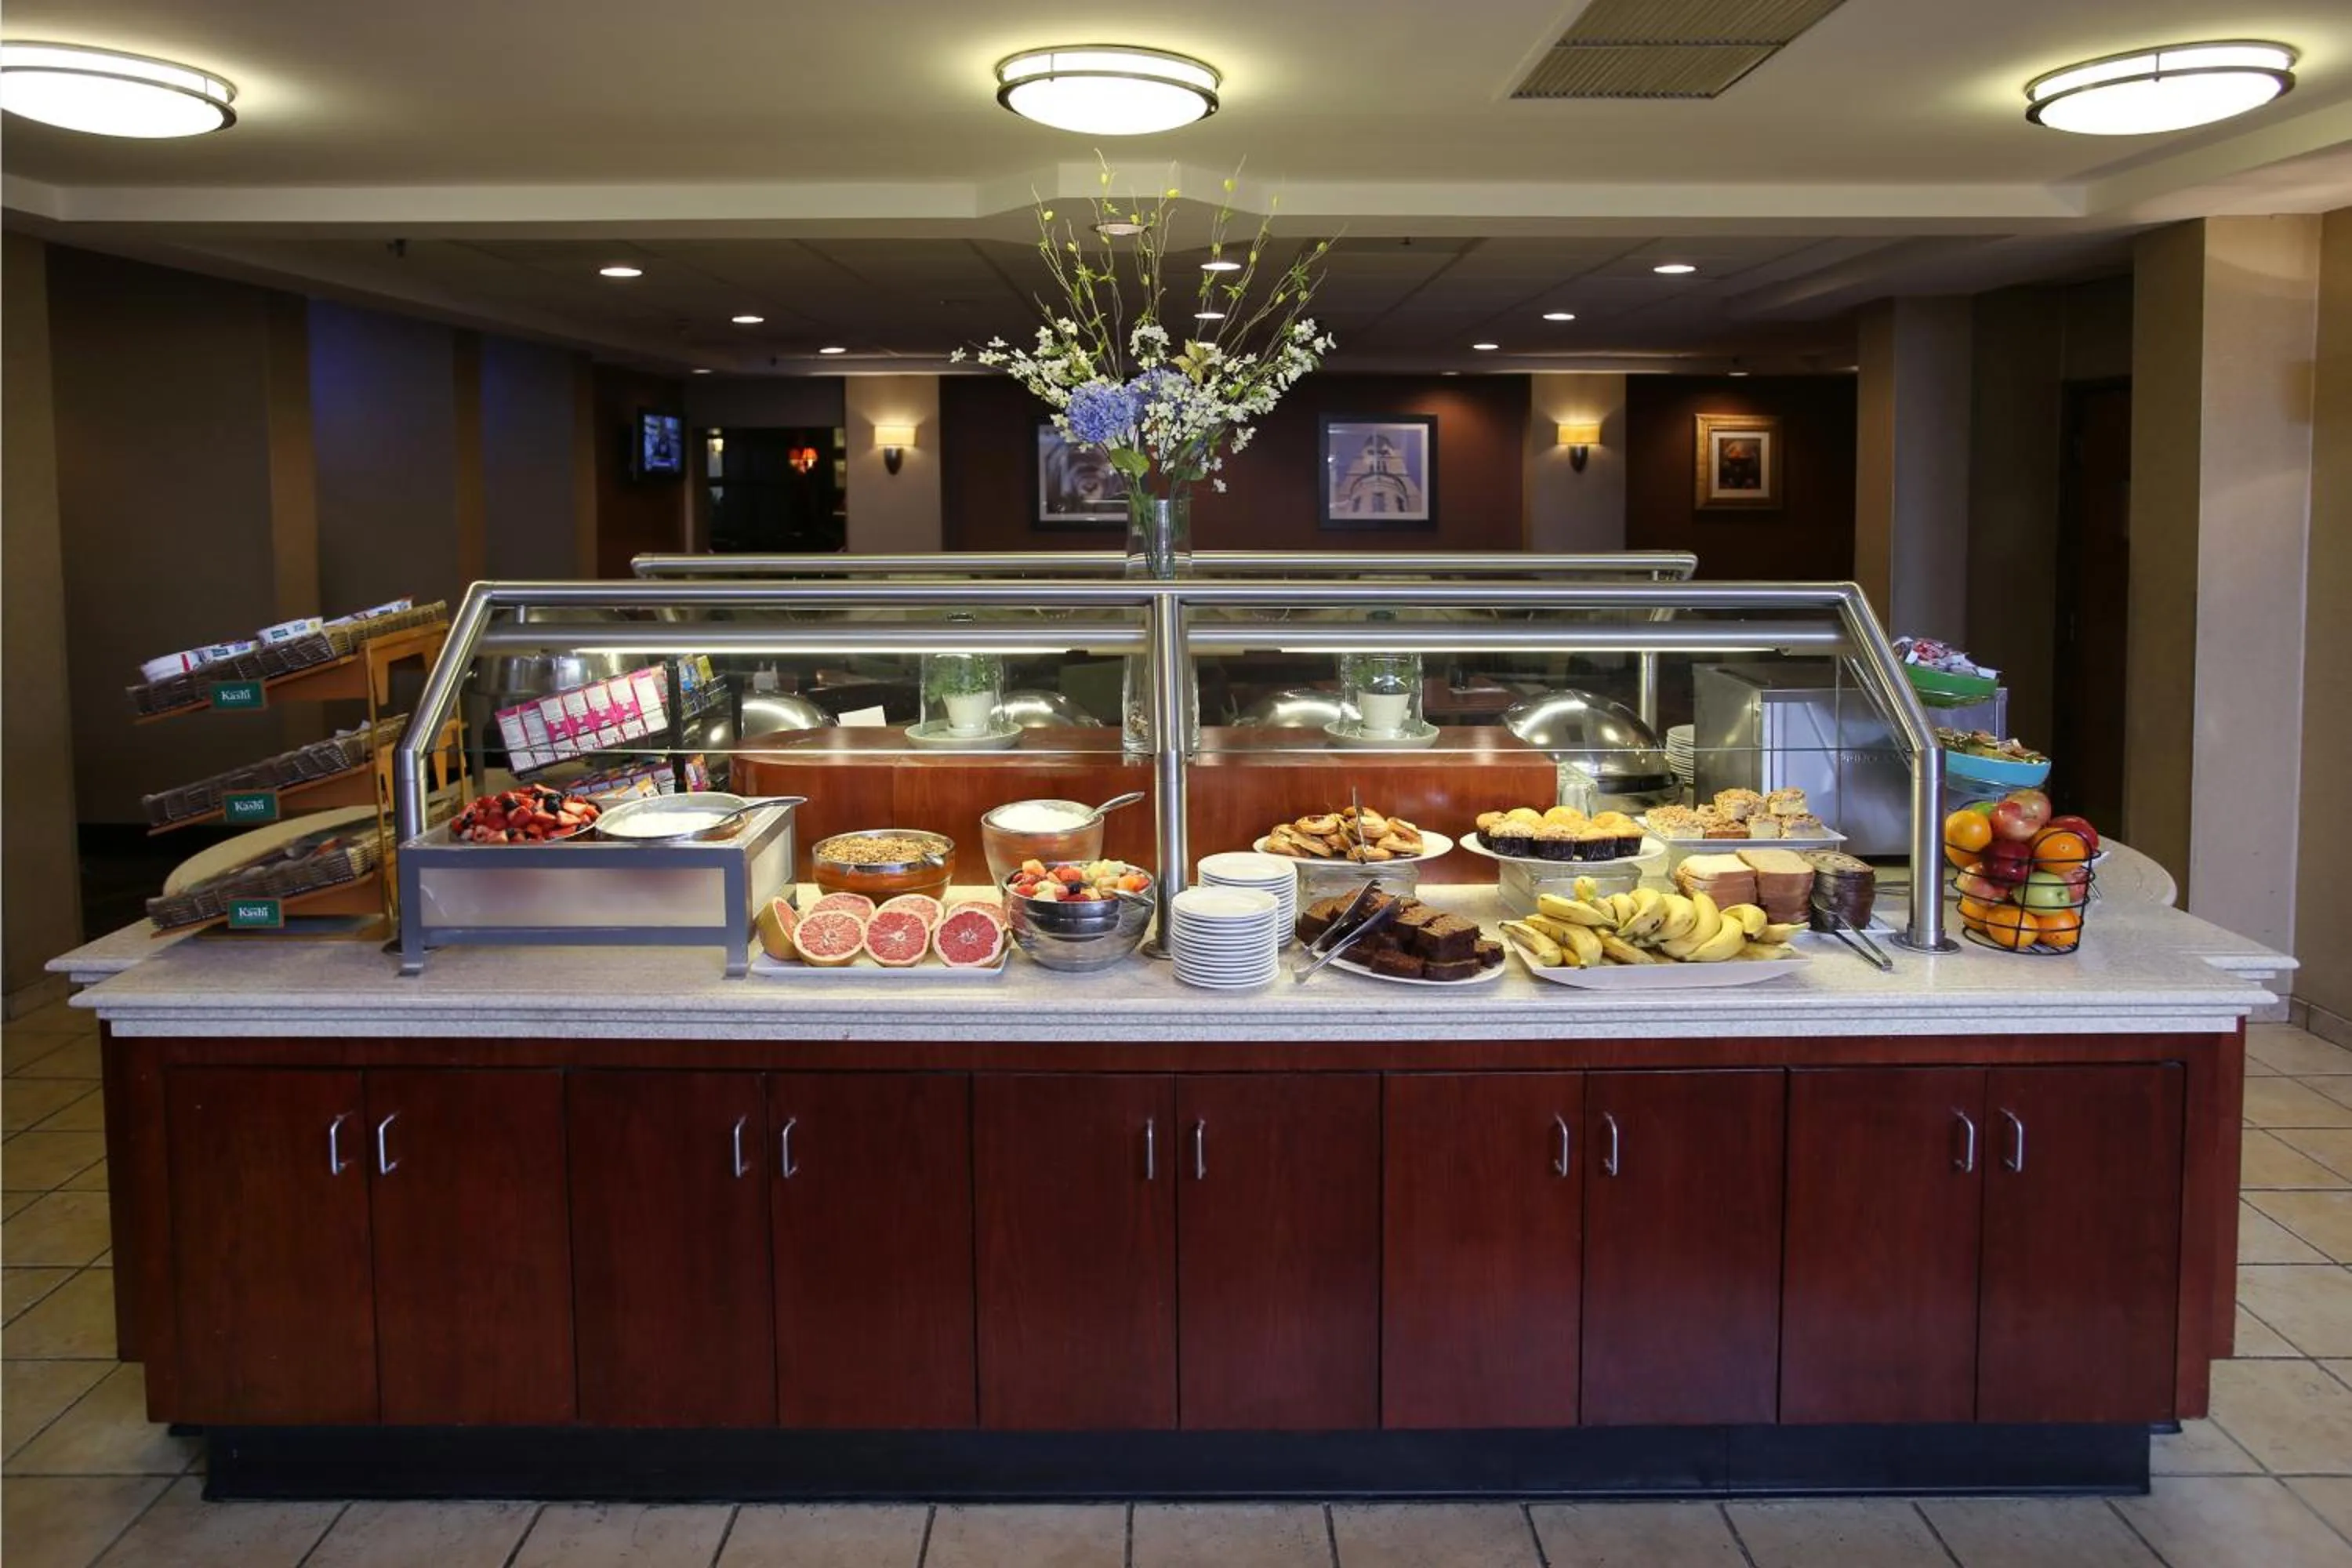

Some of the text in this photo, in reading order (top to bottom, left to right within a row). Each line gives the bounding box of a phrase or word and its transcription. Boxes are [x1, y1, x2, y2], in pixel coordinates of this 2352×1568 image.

[221, 689, 252, 700] Kashi
[234, 799, 264, 811] Kashi
[238, 906, 269, 917] Kashi
